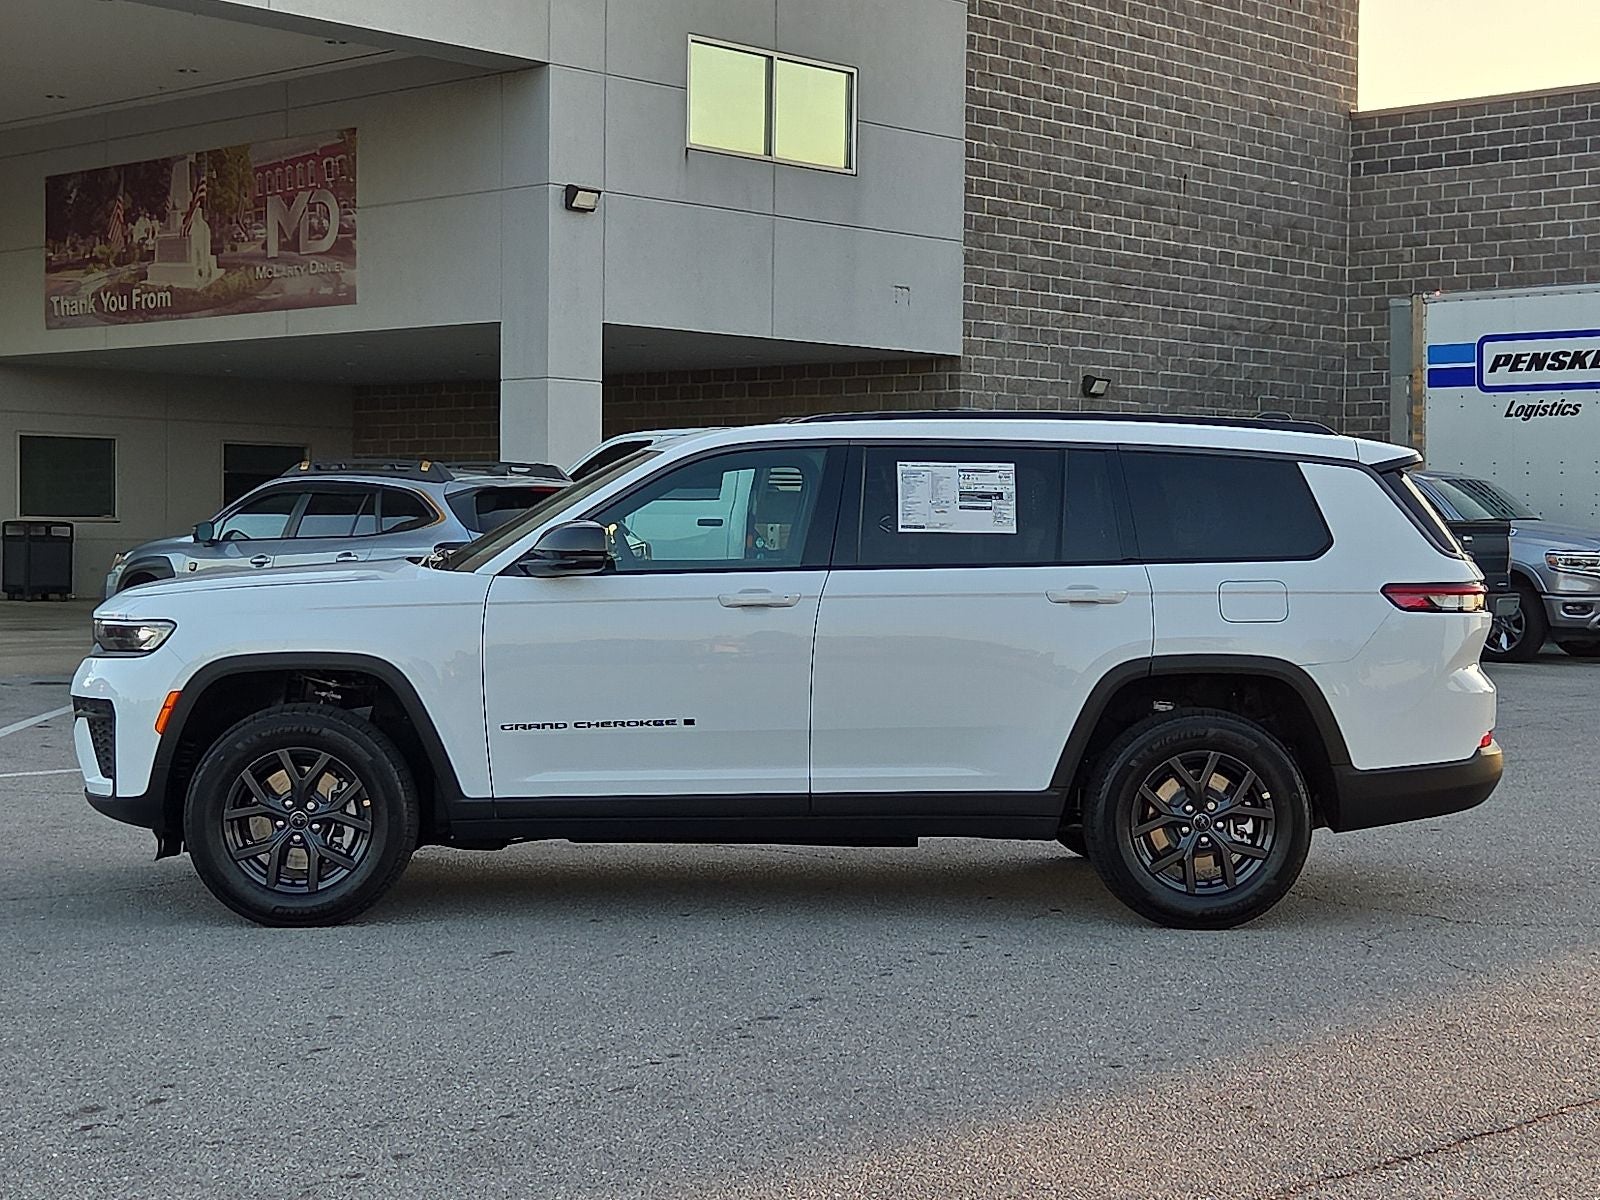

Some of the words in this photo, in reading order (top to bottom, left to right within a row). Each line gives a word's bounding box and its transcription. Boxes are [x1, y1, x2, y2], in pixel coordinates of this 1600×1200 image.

[266, 188, 340, 258] MD
[50, 293, 97, 317] Thank
[101, 291, 128, 313] You
[132, 288, 172, 310] From
[1504, 398, 1582, 422] Logistics
[500, 722, 568, 731] GRAND
[573, 718, 678, 729] CHEROKEE
